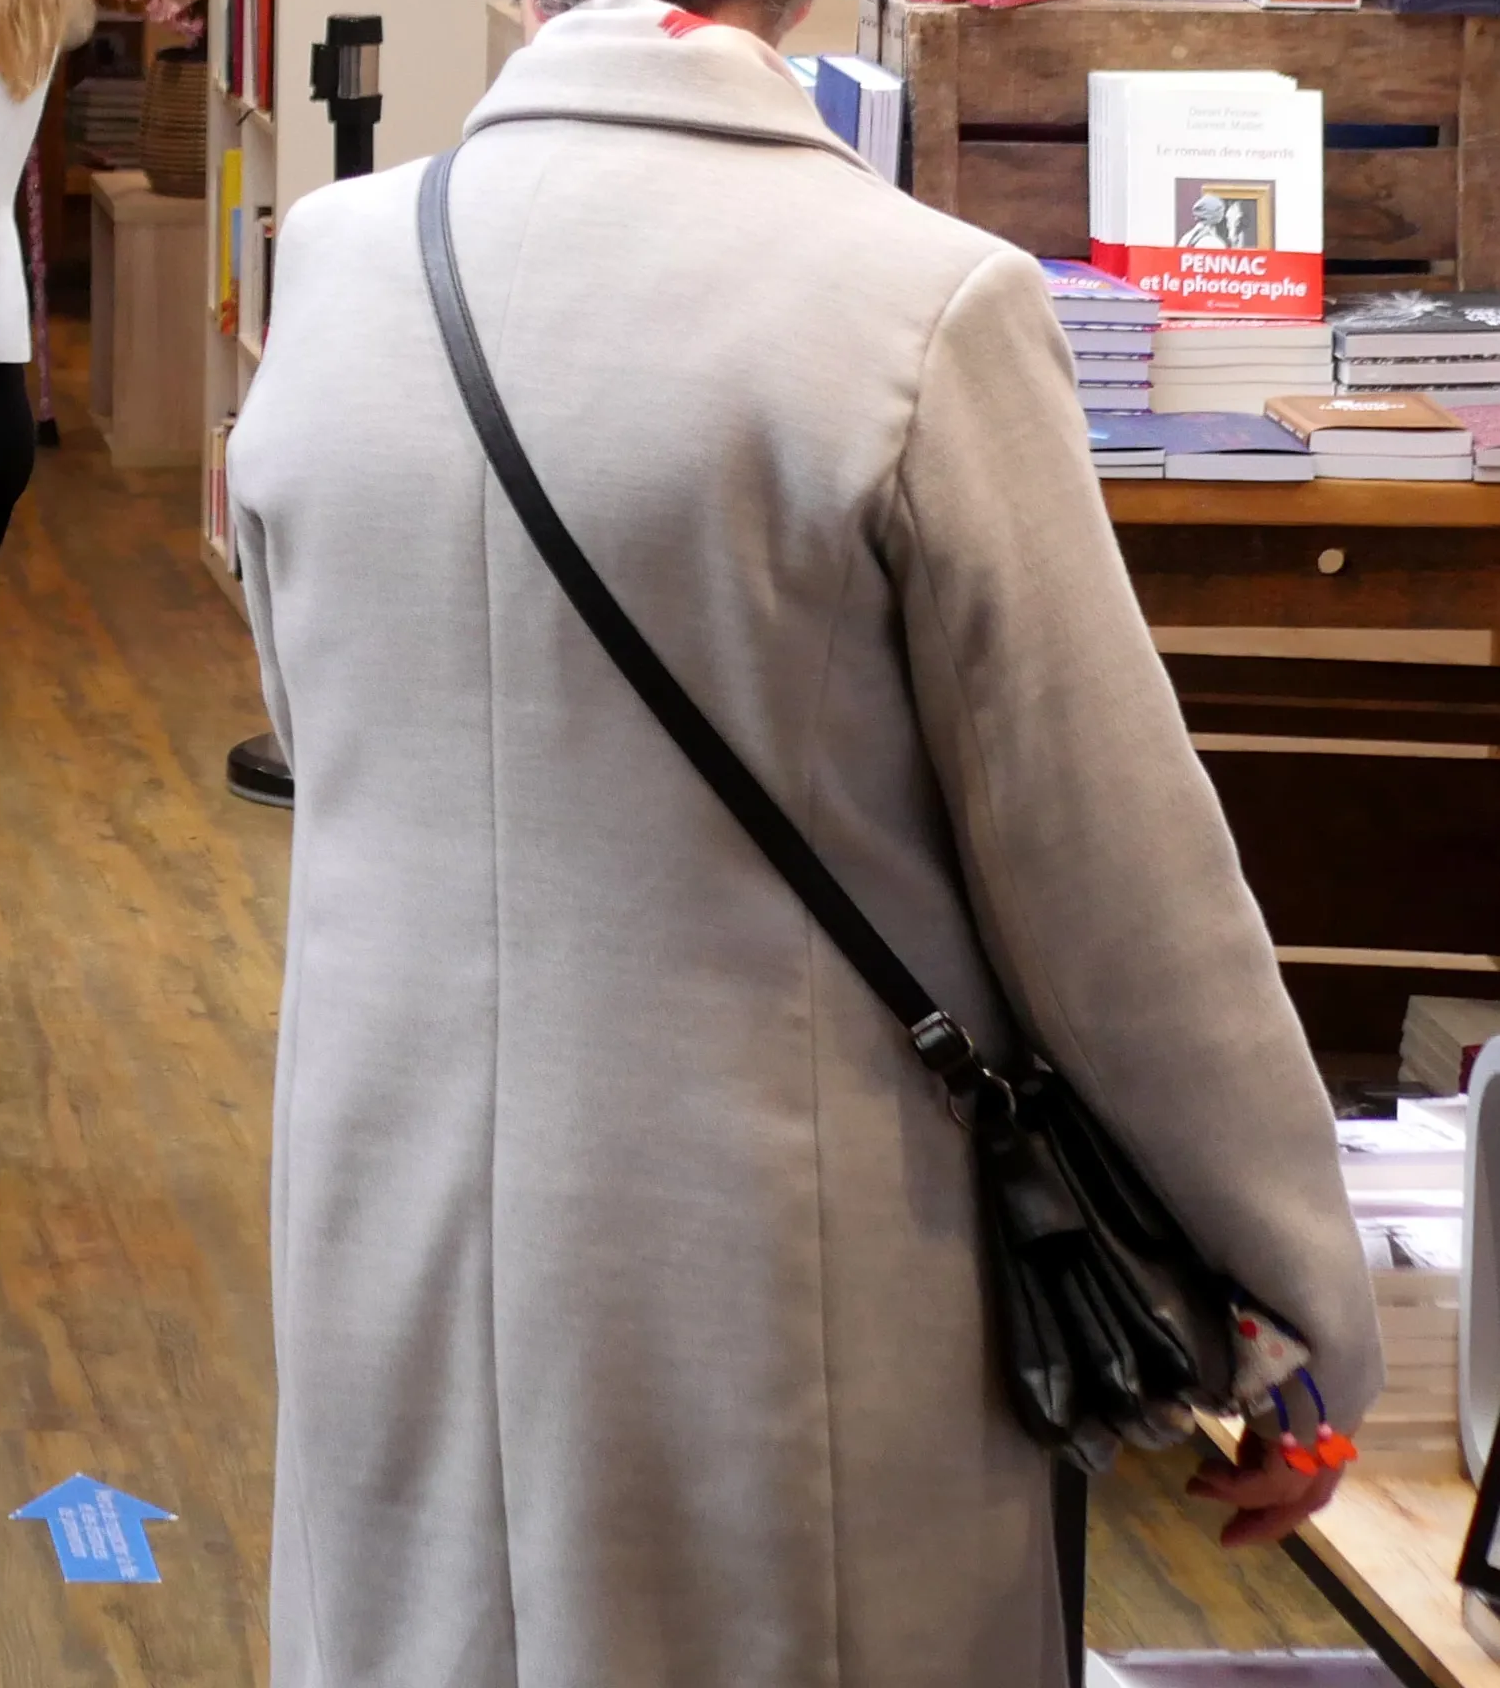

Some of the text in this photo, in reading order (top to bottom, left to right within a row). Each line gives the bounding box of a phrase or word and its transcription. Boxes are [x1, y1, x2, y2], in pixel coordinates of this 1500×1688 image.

[1174, 146, 1217, 157] roman
[1219, 146, 1243, 158] des
[1245, 147, 1295, 160] regards
[1180, 253, 1268, 276] PENNAC
[1139, 273, 1308, 301] et le photographe
